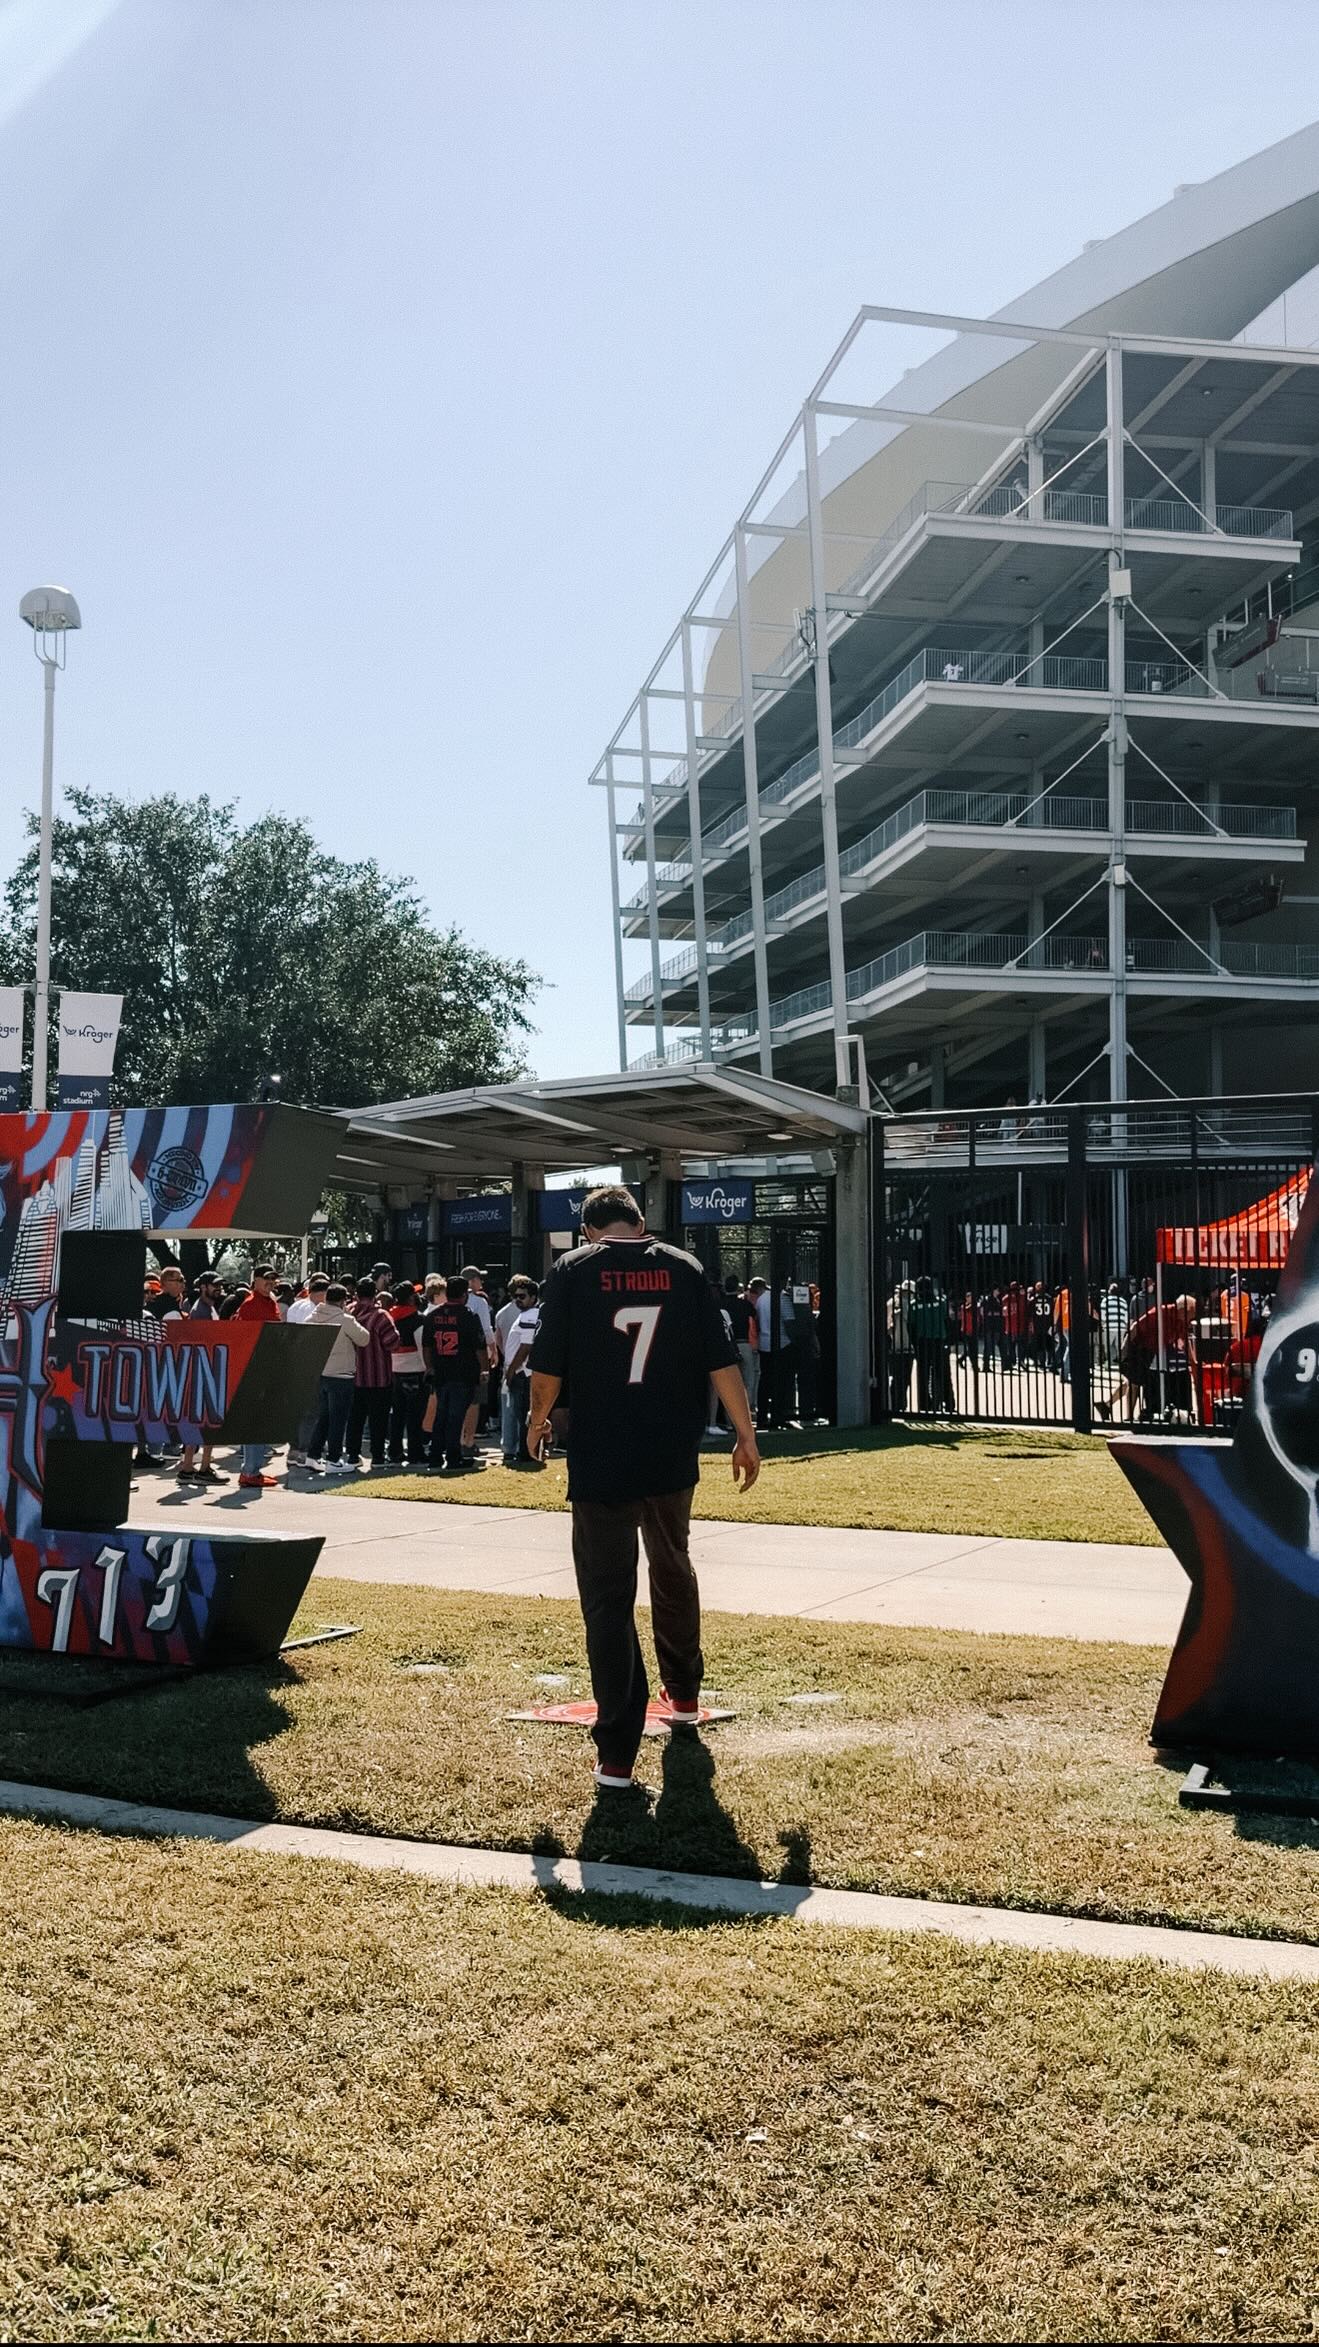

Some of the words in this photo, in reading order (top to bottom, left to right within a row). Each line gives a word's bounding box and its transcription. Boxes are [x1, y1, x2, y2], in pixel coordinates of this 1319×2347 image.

[79, 1025, 113, 1043] Kroger
[705, 1187, 747, 1217] Kroger
[601, 1270, 672, 1291] STROUD
[1035, 1303, 1050, 1316] 30
[434, 1331, 459, 1355] 12
[613, 1305, 662, 1384] 7
[79, 1343, 228, 1426] TOWN
[38, 1536, 192, 1652] 713
